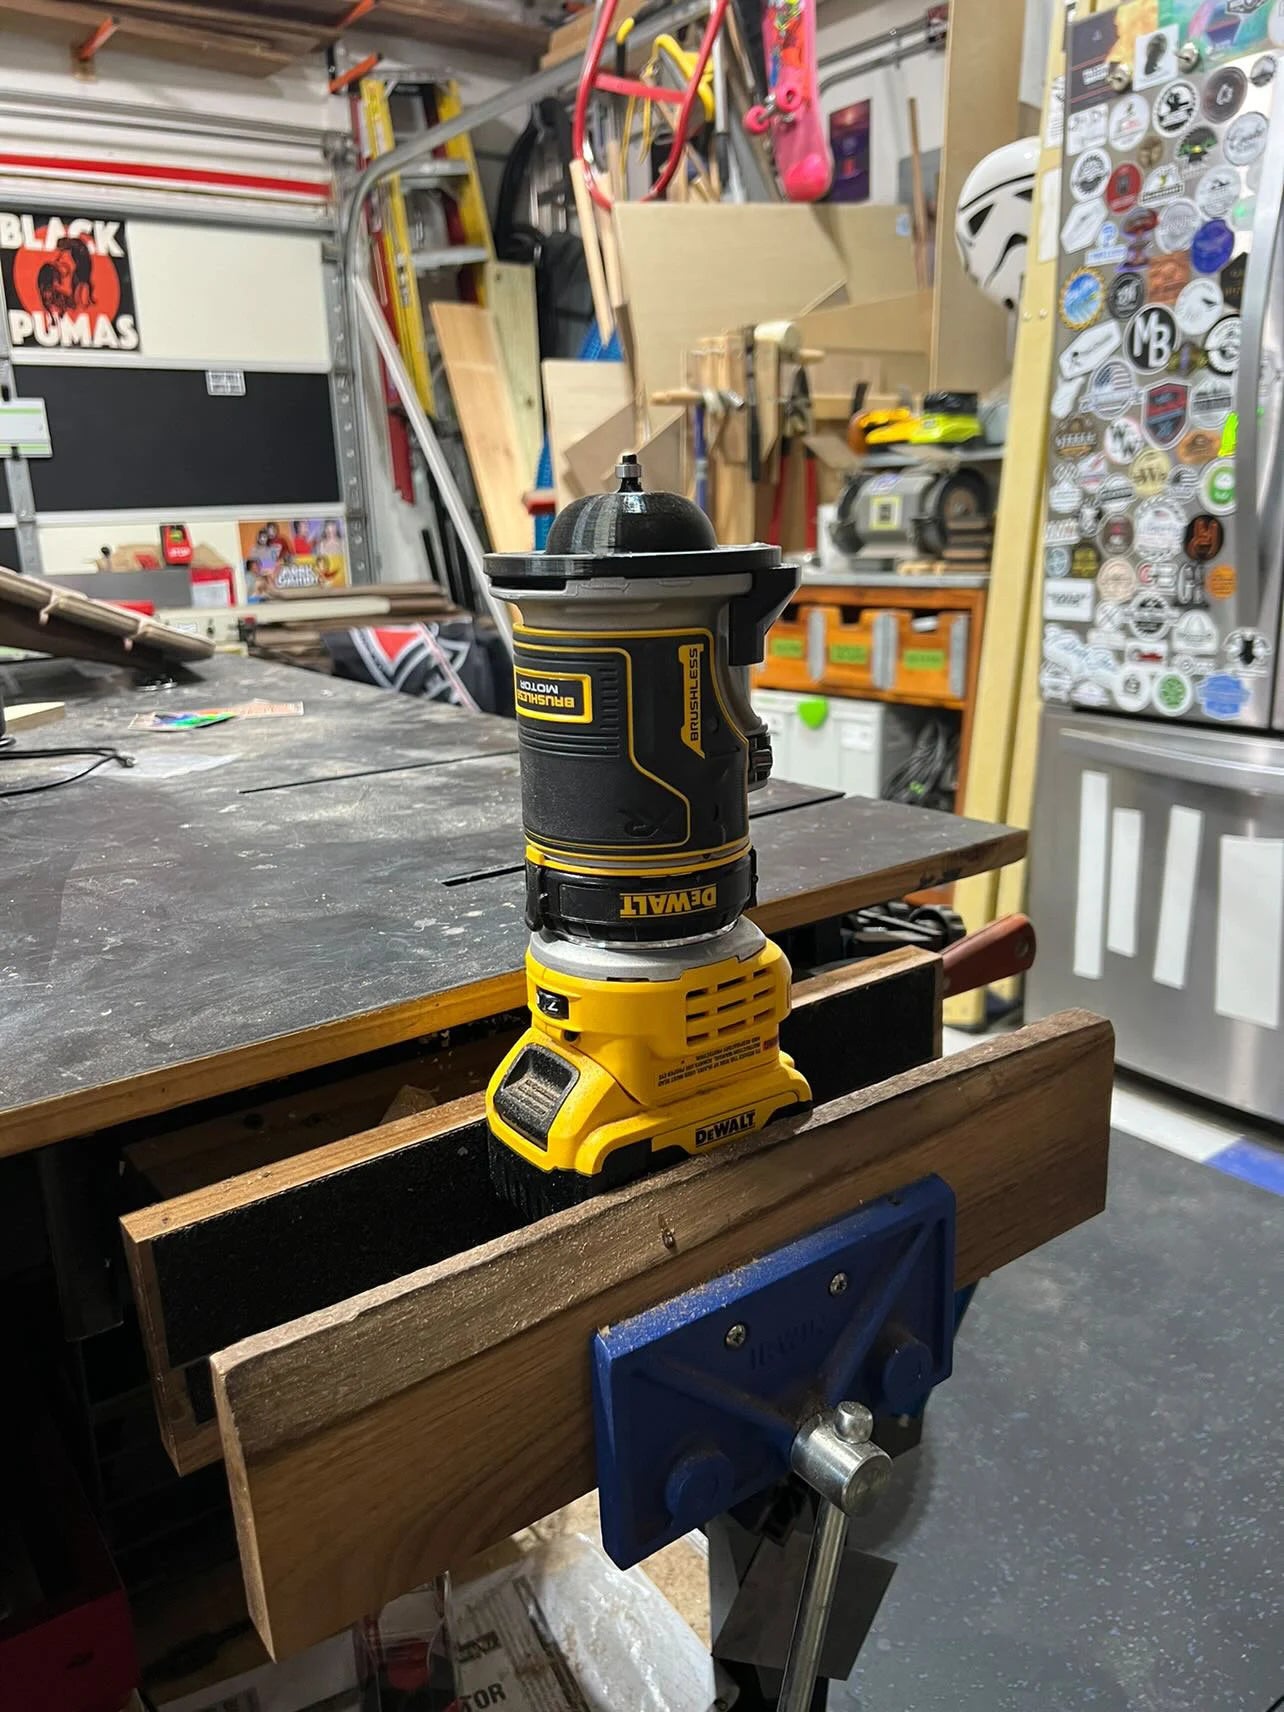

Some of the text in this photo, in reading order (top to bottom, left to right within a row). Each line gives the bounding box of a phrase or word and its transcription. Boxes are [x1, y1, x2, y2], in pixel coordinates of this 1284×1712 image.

[0, 212, 125, 257] BLACK
[7, 309, 139, 350] PUMAS
[519, 679, 559, 695] MOTOR
[690, 647, 699, 742] BRUSHLESS
[619, 884, 717, 918] DEWALT
[695, 1110, 756, 1147] DEWALT
